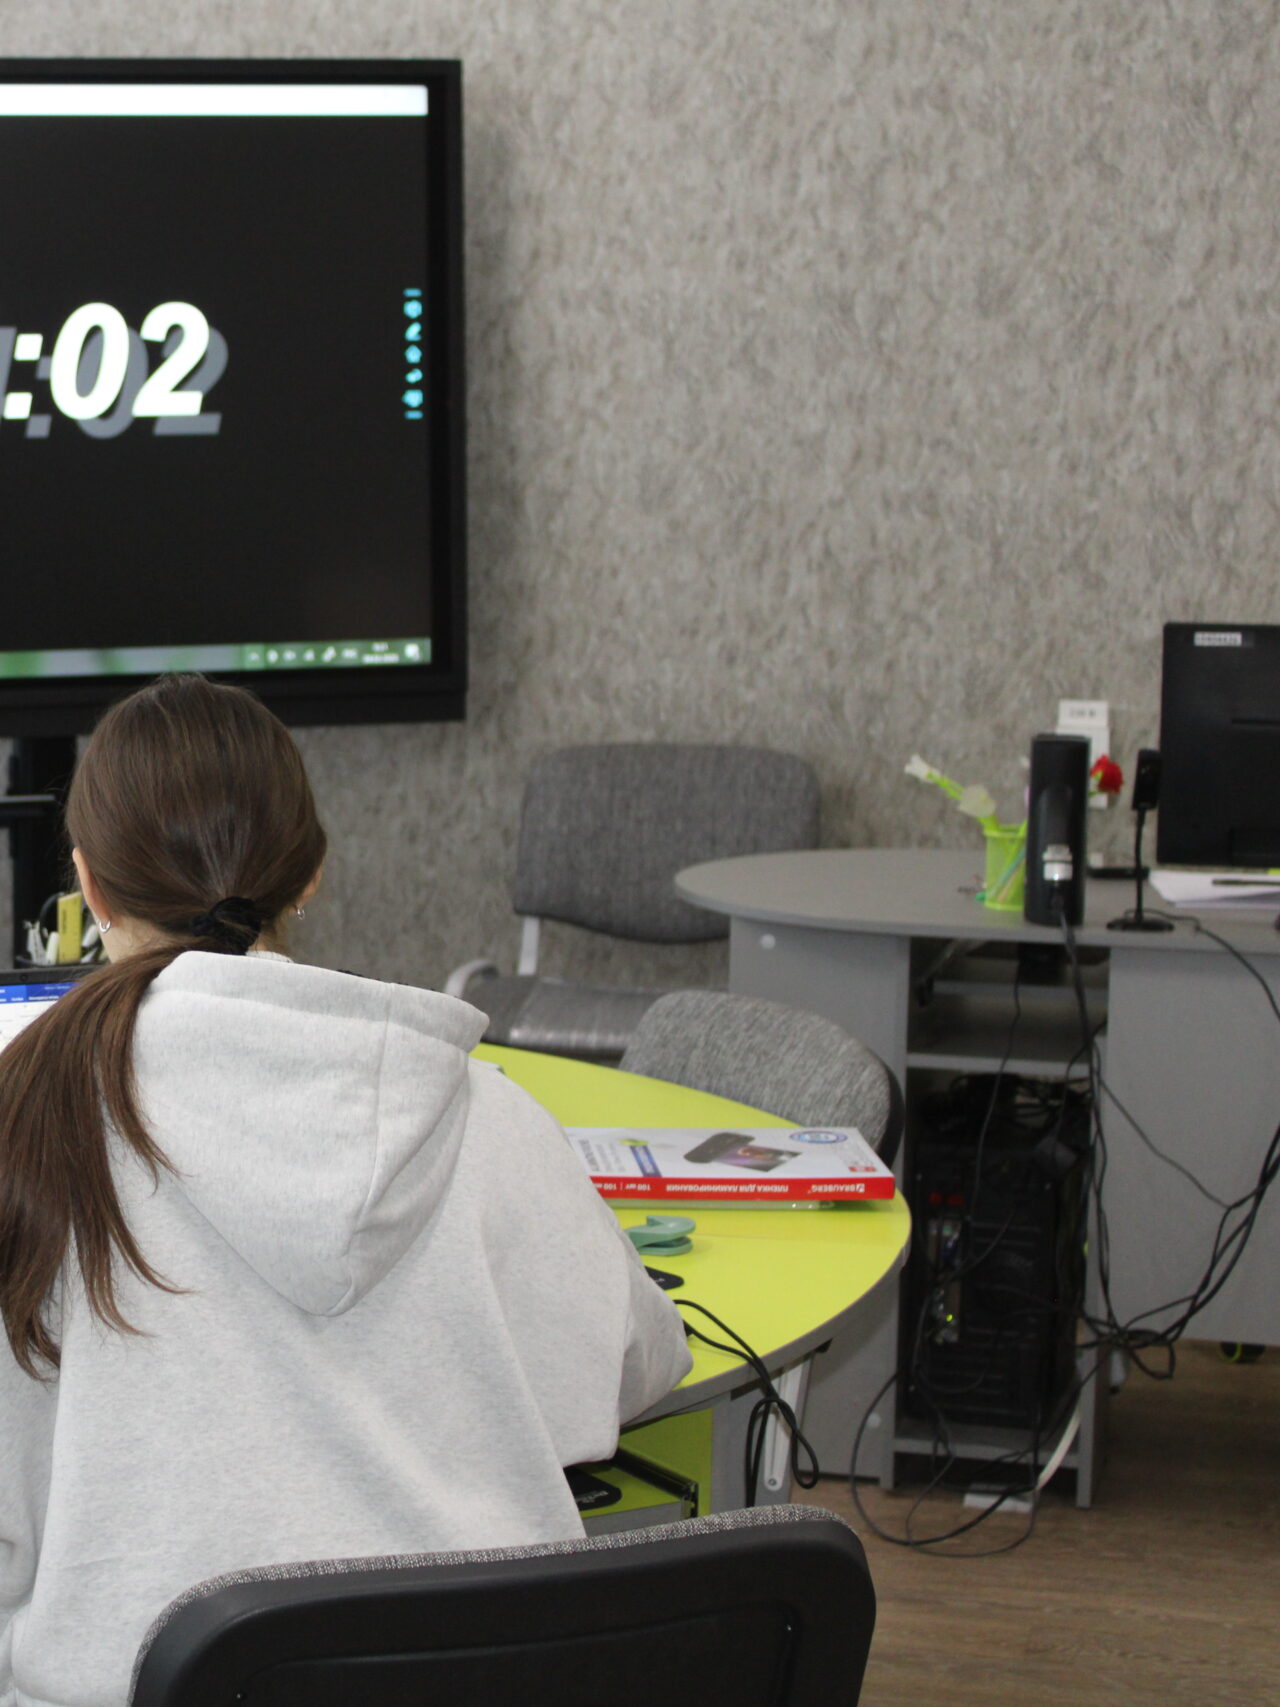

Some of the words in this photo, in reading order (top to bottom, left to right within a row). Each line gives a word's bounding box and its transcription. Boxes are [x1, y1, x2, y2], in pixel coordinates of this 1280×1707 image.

[637, 1183, 651, 1191] 100
[665, 1183, 738, 1193] ЛАМИНИРОВАНИЯ
[738, 1184, 756, 1193] ДЛЯ
[810, 1183, 858, 1193] BRAUBERG
